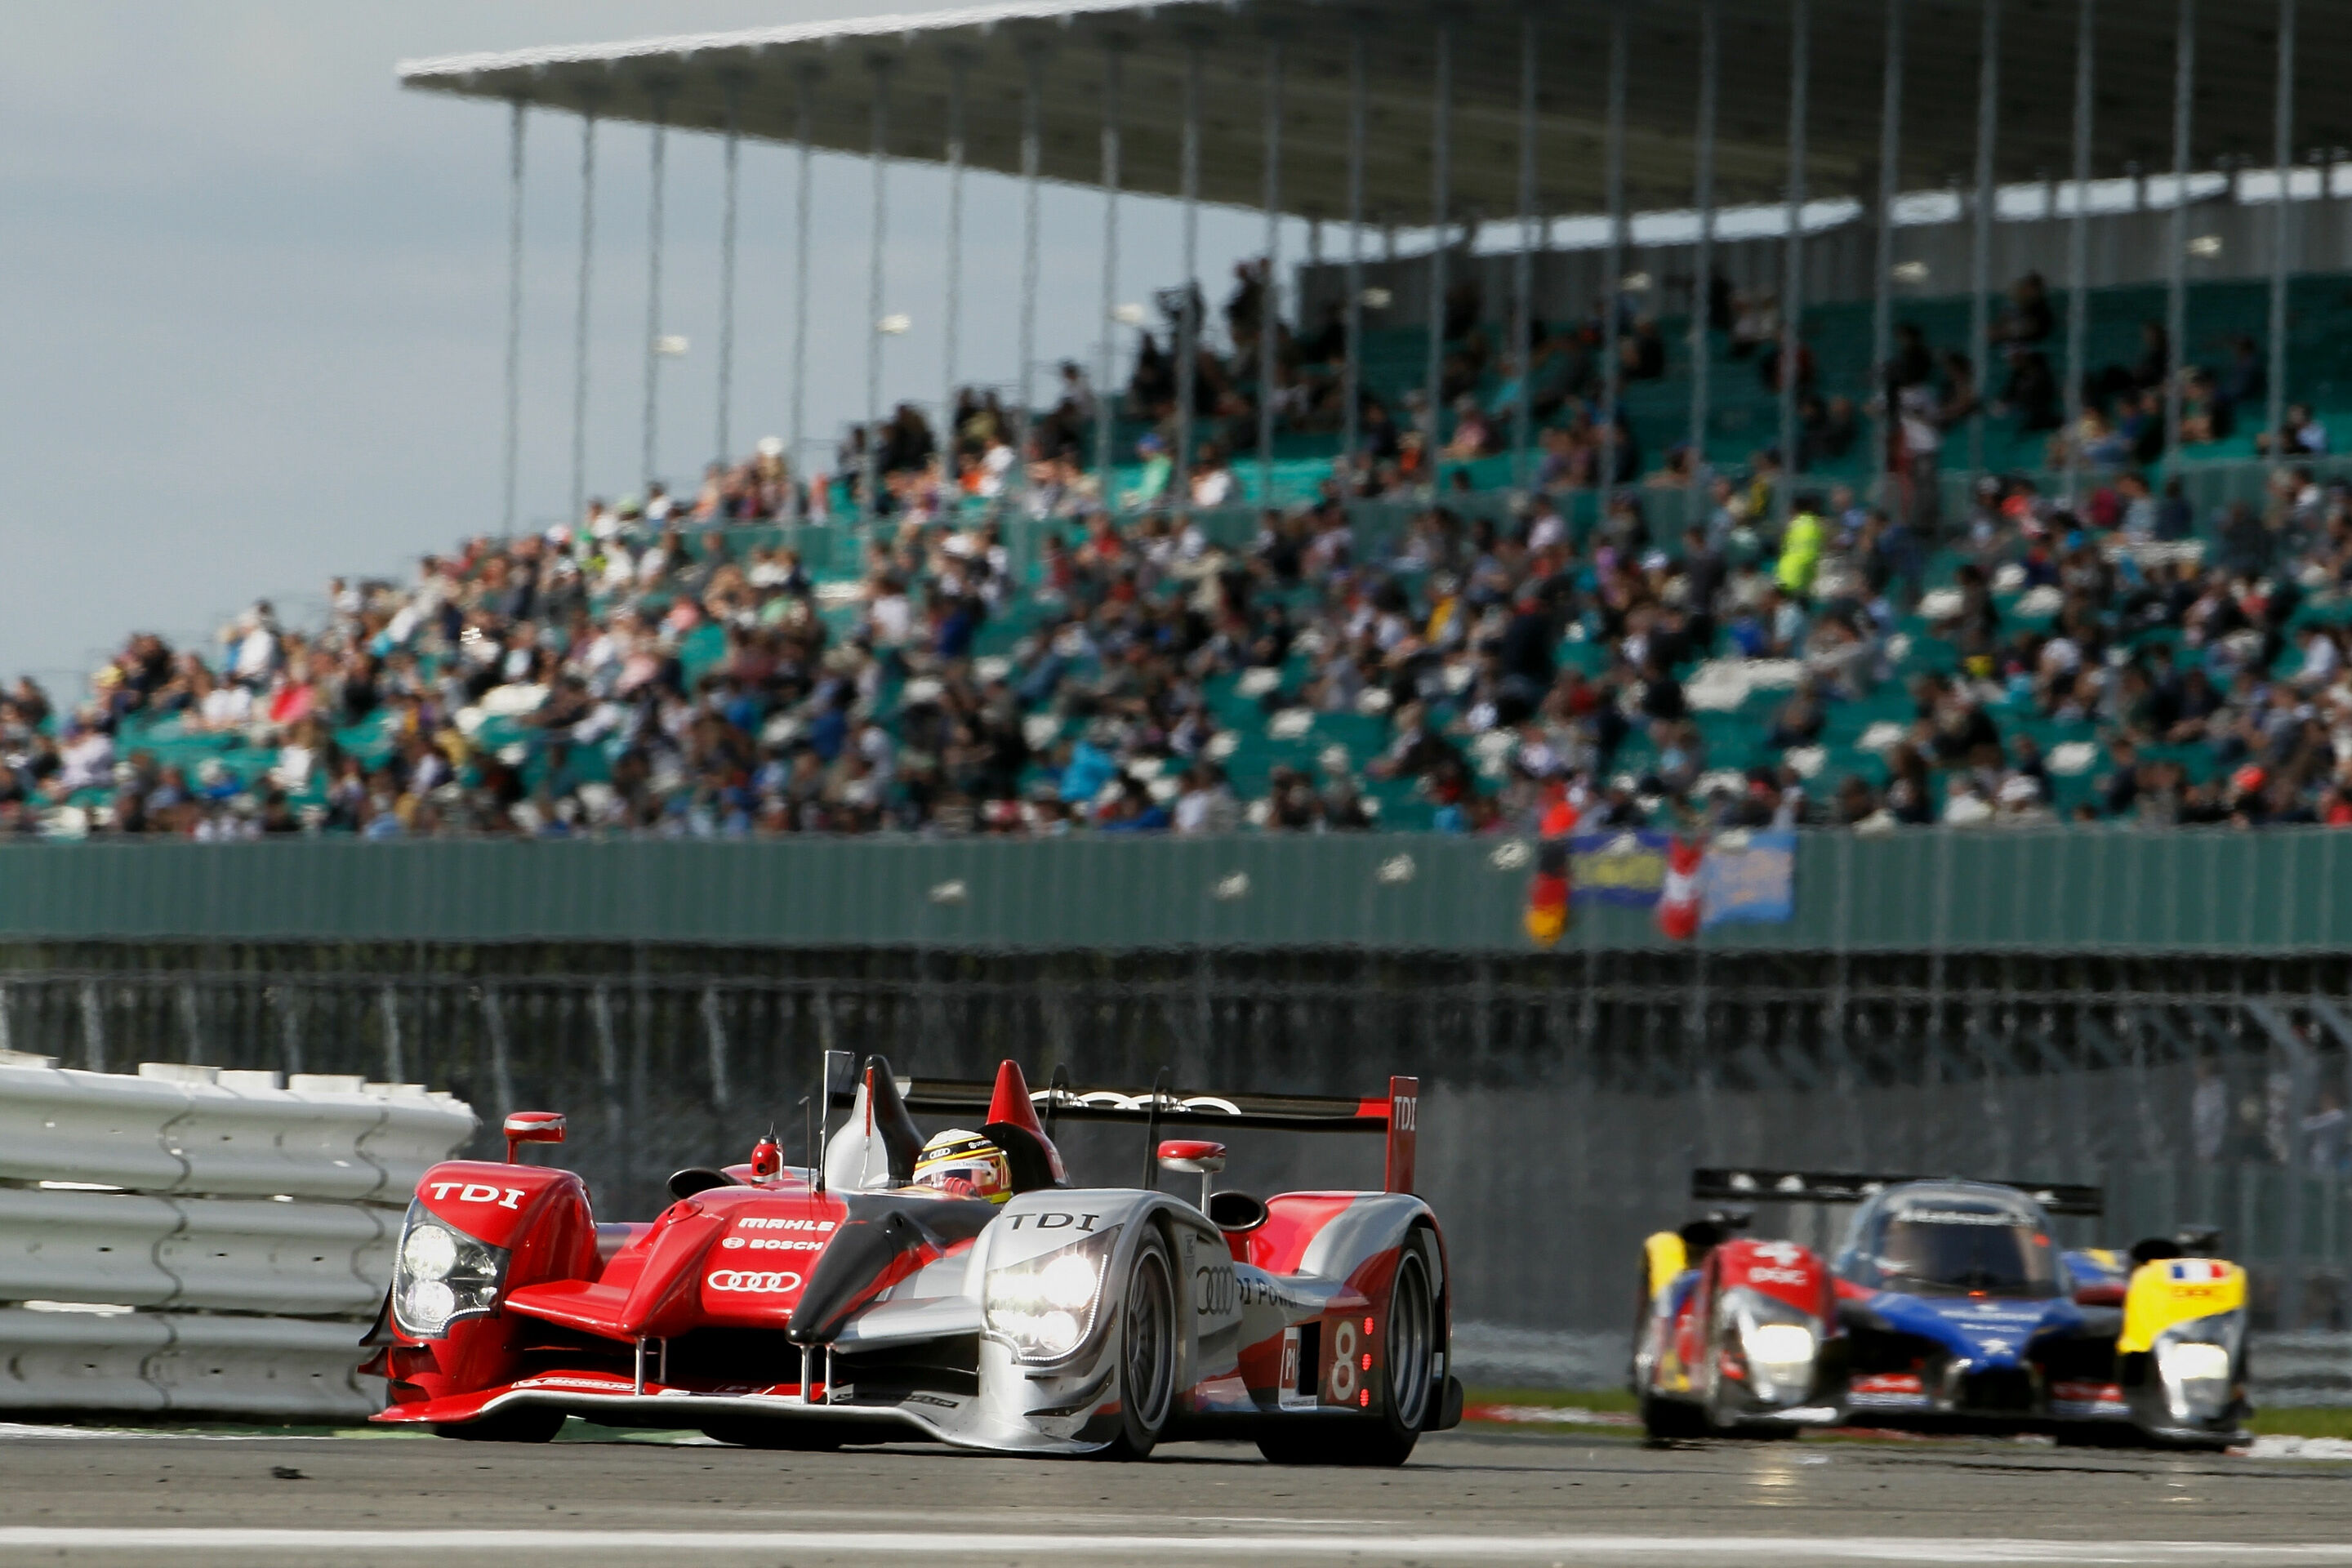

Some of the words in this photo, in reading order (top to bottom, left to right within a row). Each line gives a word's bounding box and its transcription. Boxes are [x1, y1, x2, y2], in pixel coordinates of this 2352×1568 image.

[1394, 1096, 1417, 1131] TDI
[430, 1183, 525, 1209] TDI
[738, 1218, 835, 1232] MAHLE
[1006, 1213, 1099, 1232] TDI
[749, 1239, 824, 1250] BOSCH
[1285, 1348, 1296, 1380] P1
[1332, 1321, 1356, 1401] 8
